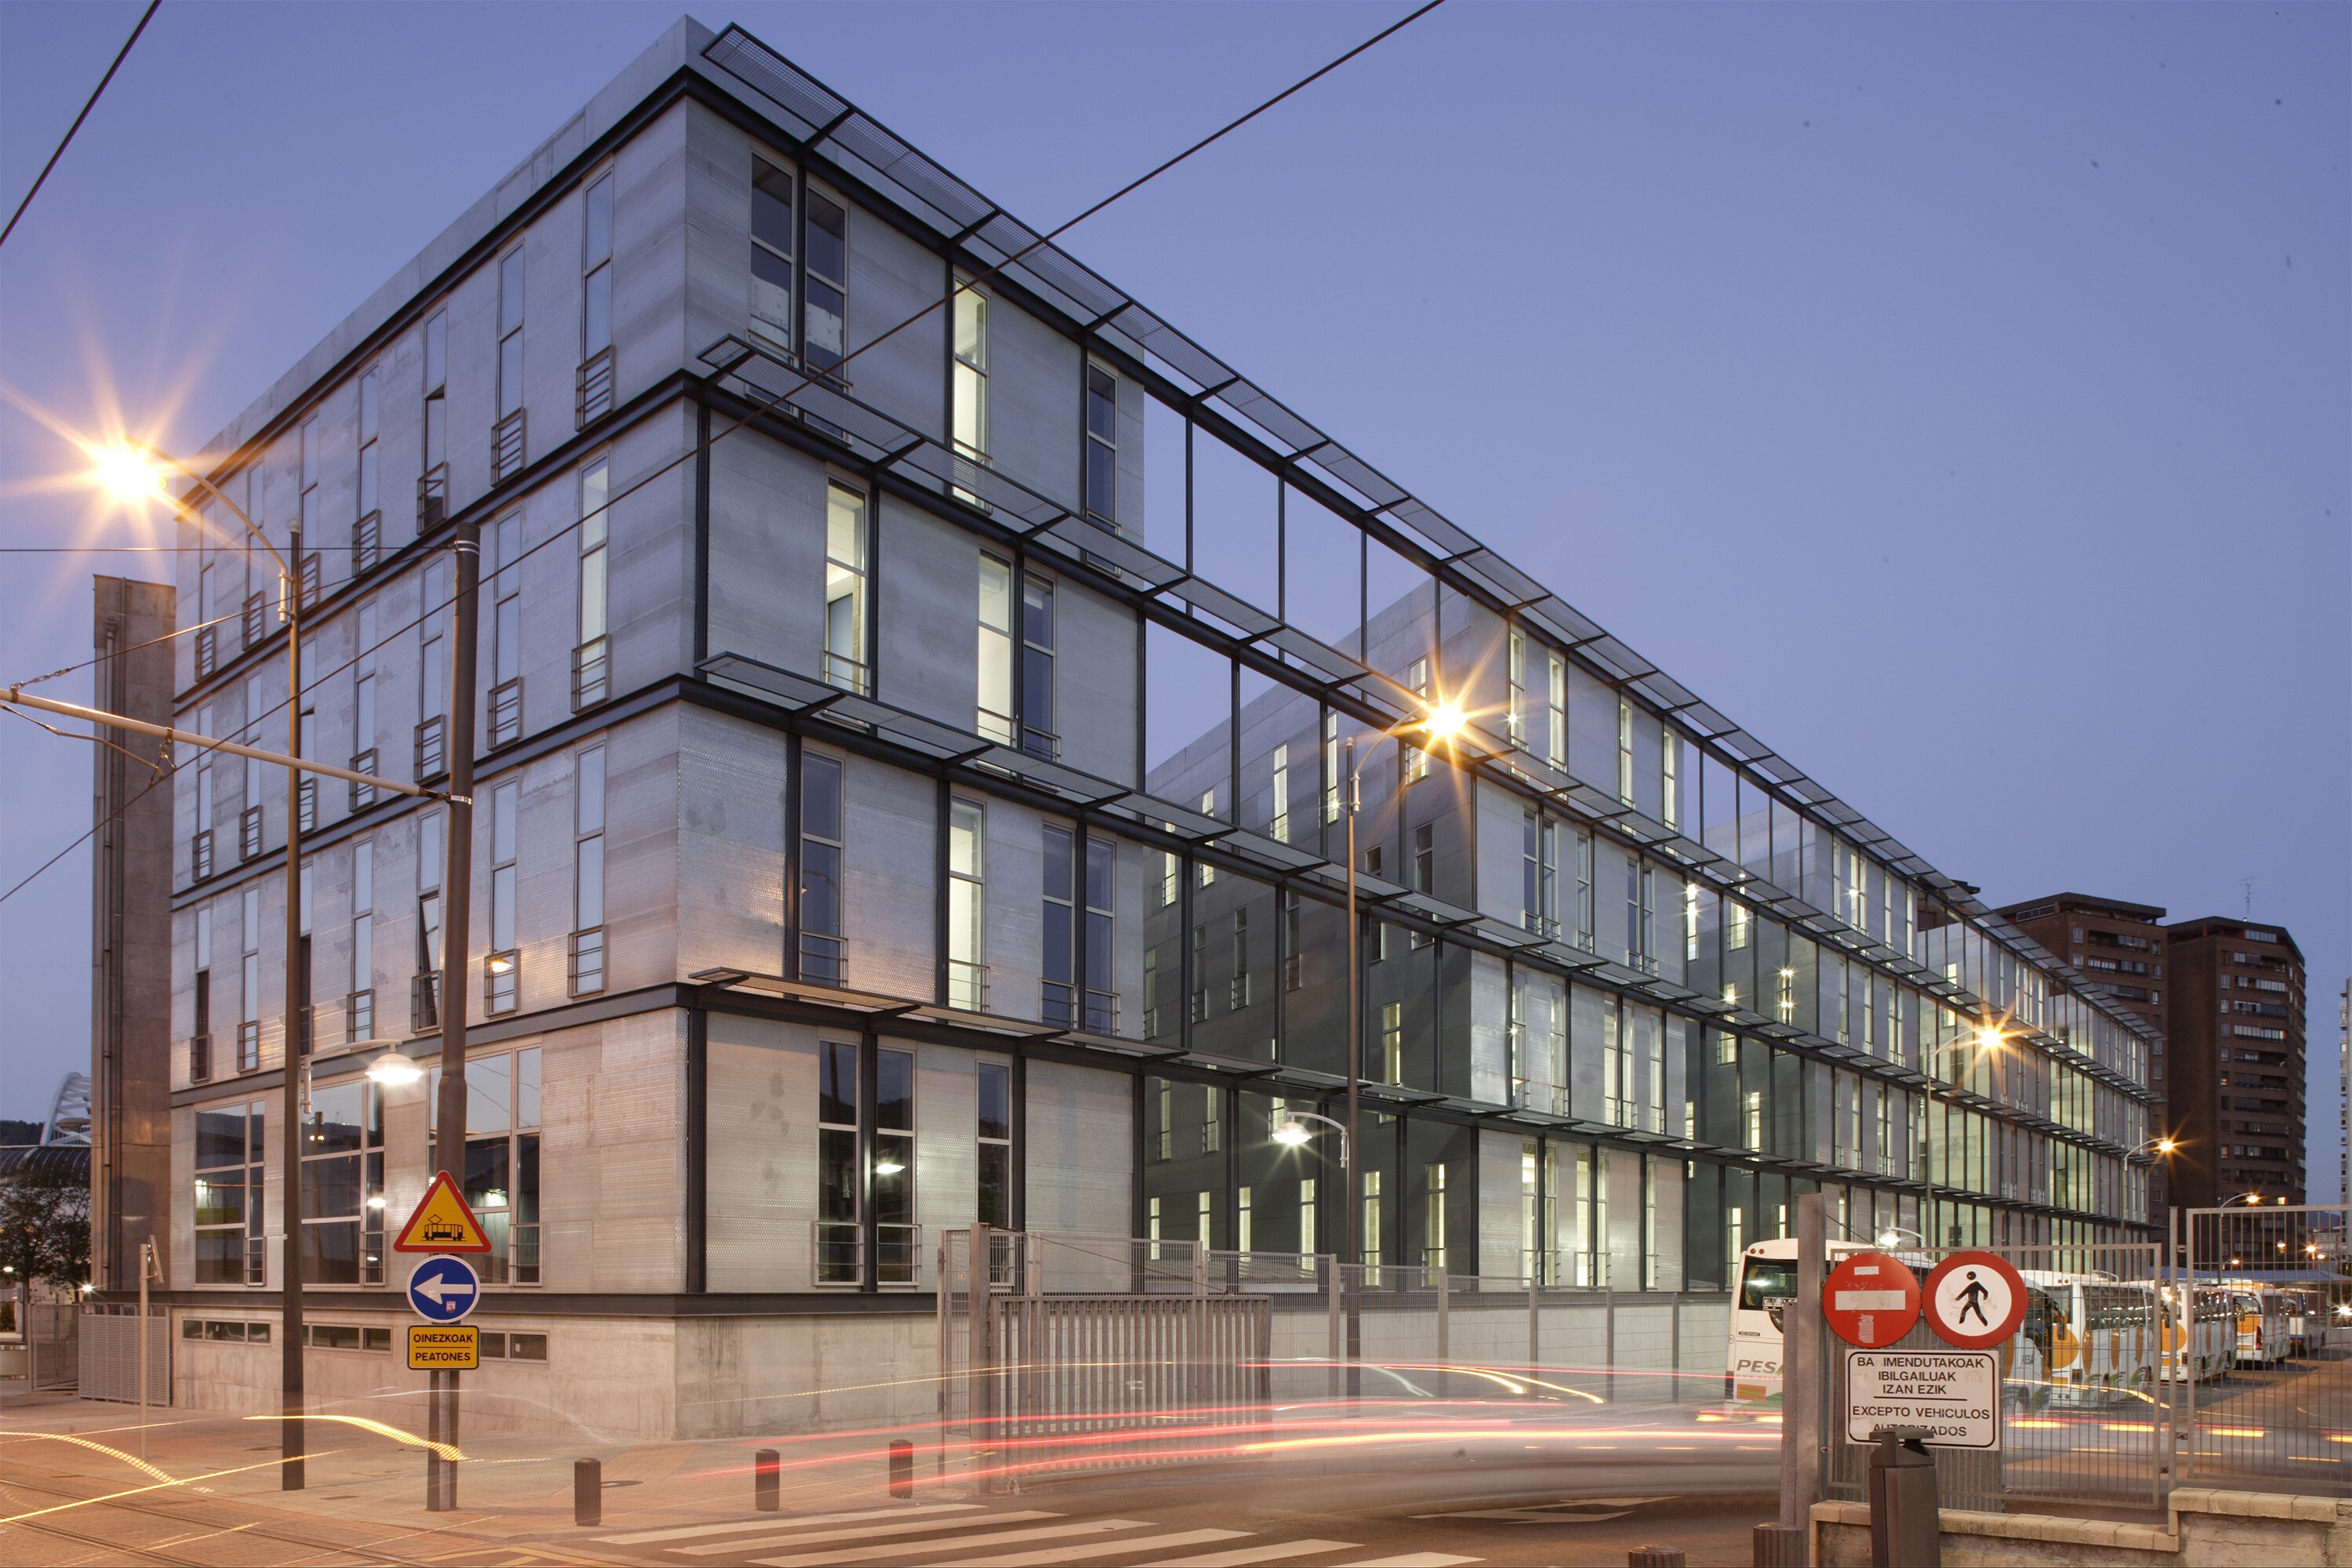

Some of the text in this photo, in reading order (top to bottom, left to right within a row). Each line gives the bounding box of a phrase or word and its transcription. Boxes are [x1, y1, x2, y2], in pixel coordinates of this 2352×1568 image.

[413, 1334, 474, 1343] OINEZKOAK
[415, 1352, 471, 1361] PEATONES
[1857, 1357, 1985, 1368] BA IMENDUTAKOAK
[1878, 1371, 1957, 1381] IBILGAILUAK
[1882, 1385, 1947, 1395] IZAN EZIK
[1853, 1406, 1990, 1420] EXCEPTO VEHICULOS
